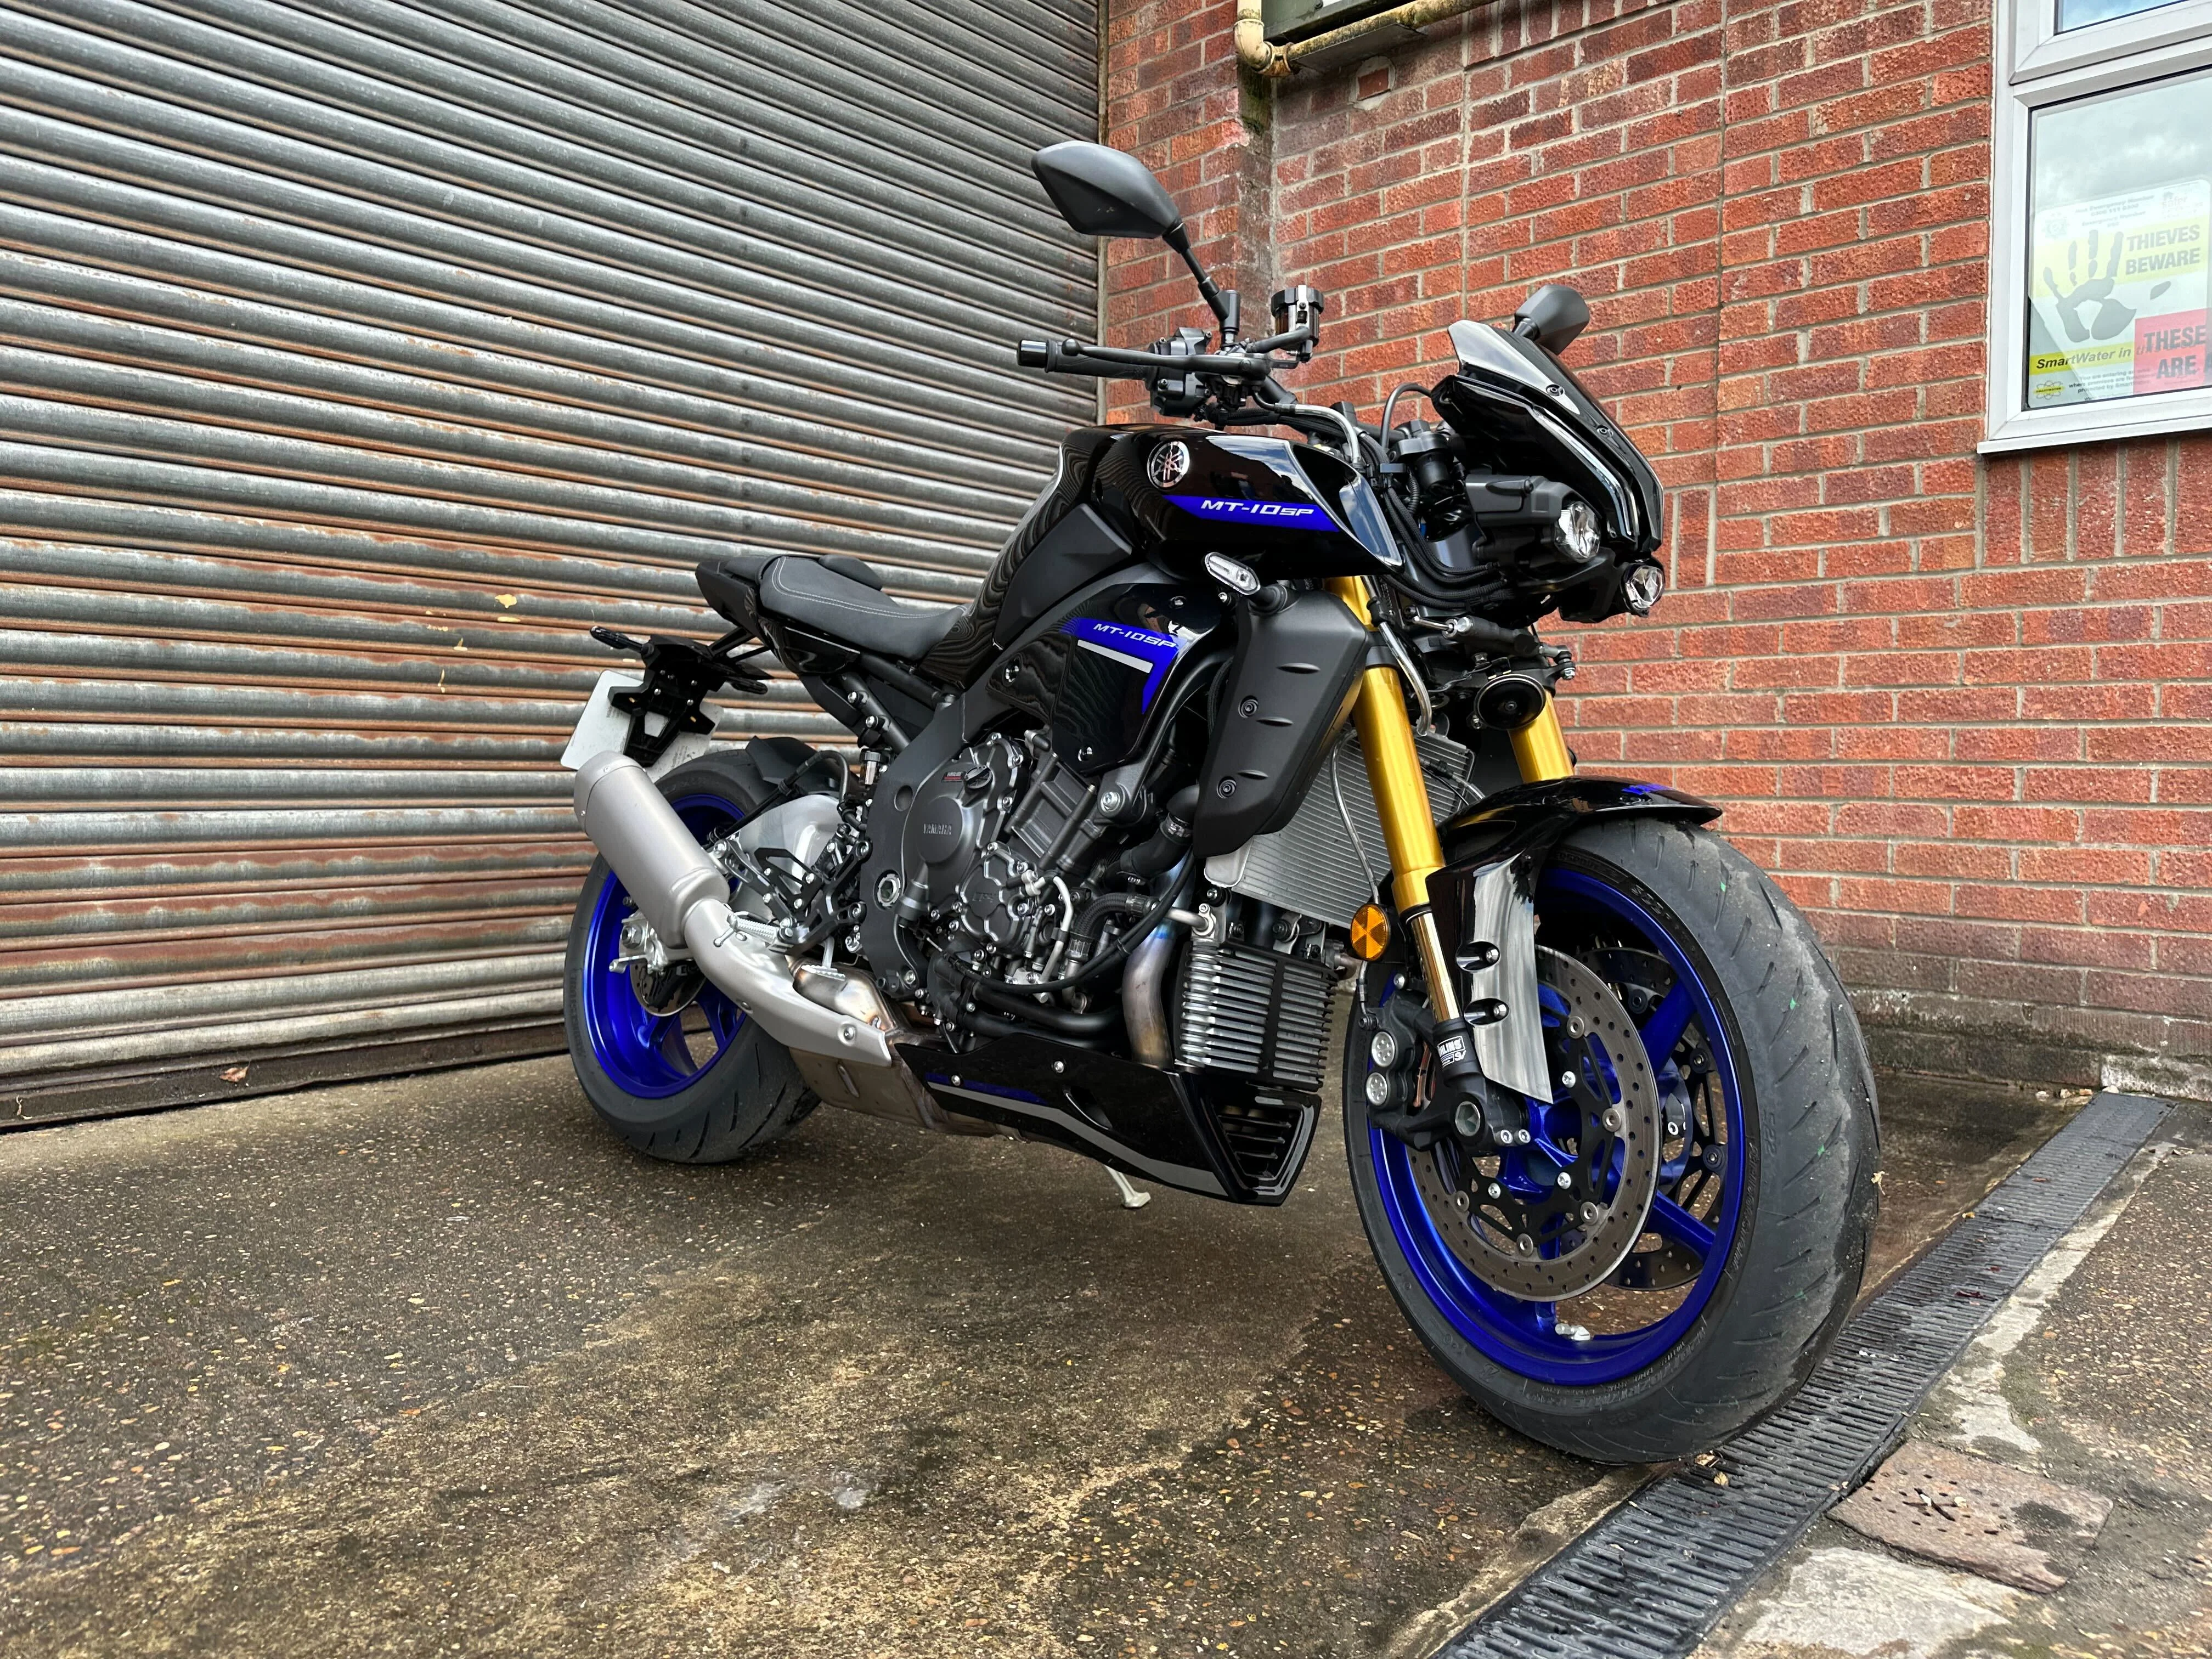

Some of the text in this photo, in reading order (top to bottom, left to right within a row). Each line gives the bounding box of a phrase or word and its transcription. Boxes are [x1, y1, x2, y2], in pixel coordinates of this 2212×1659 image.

[2126, 224, 2200, 252] THIEVES
[2126, 247, 2200, 275] BEWARE
[2144, 324, 2206, 352] THESE
[2036, 351, 2114, 369] SmartWater
[2118, 347, 2131, 358] in
[2155, 355, 2198, 379] ARE
[923, 823, 952, 835] YAMAHA
